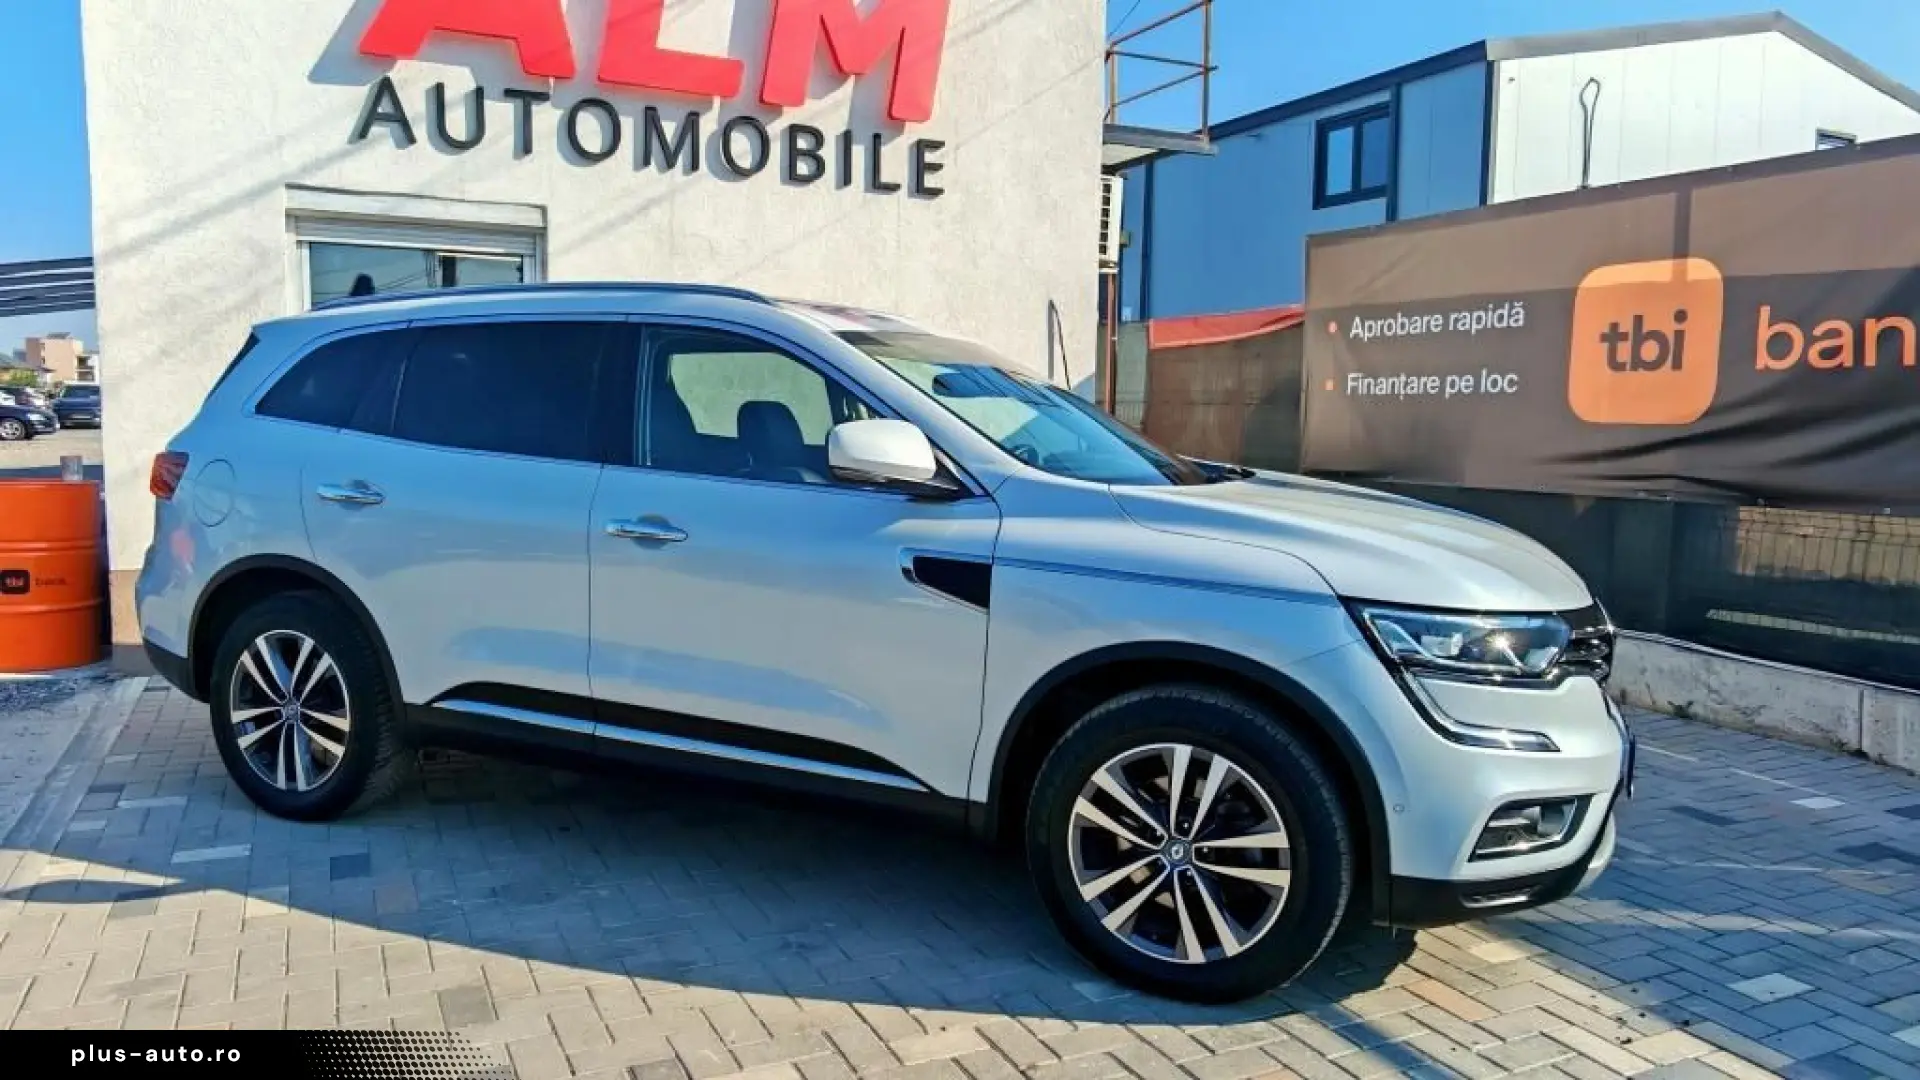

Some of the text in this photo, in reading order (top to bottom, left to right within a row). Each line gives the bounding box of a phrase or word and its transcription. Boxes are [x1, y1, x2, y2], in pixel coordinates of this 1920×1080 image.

[357, 75, 946, 197] AUTOMOBILE
[1350, 301, 1525, 342] Aprobare rapidă
[1599, 308, 1688, 372] tbi
[1346, 368, 1519, 401] Finanțare pe loc
